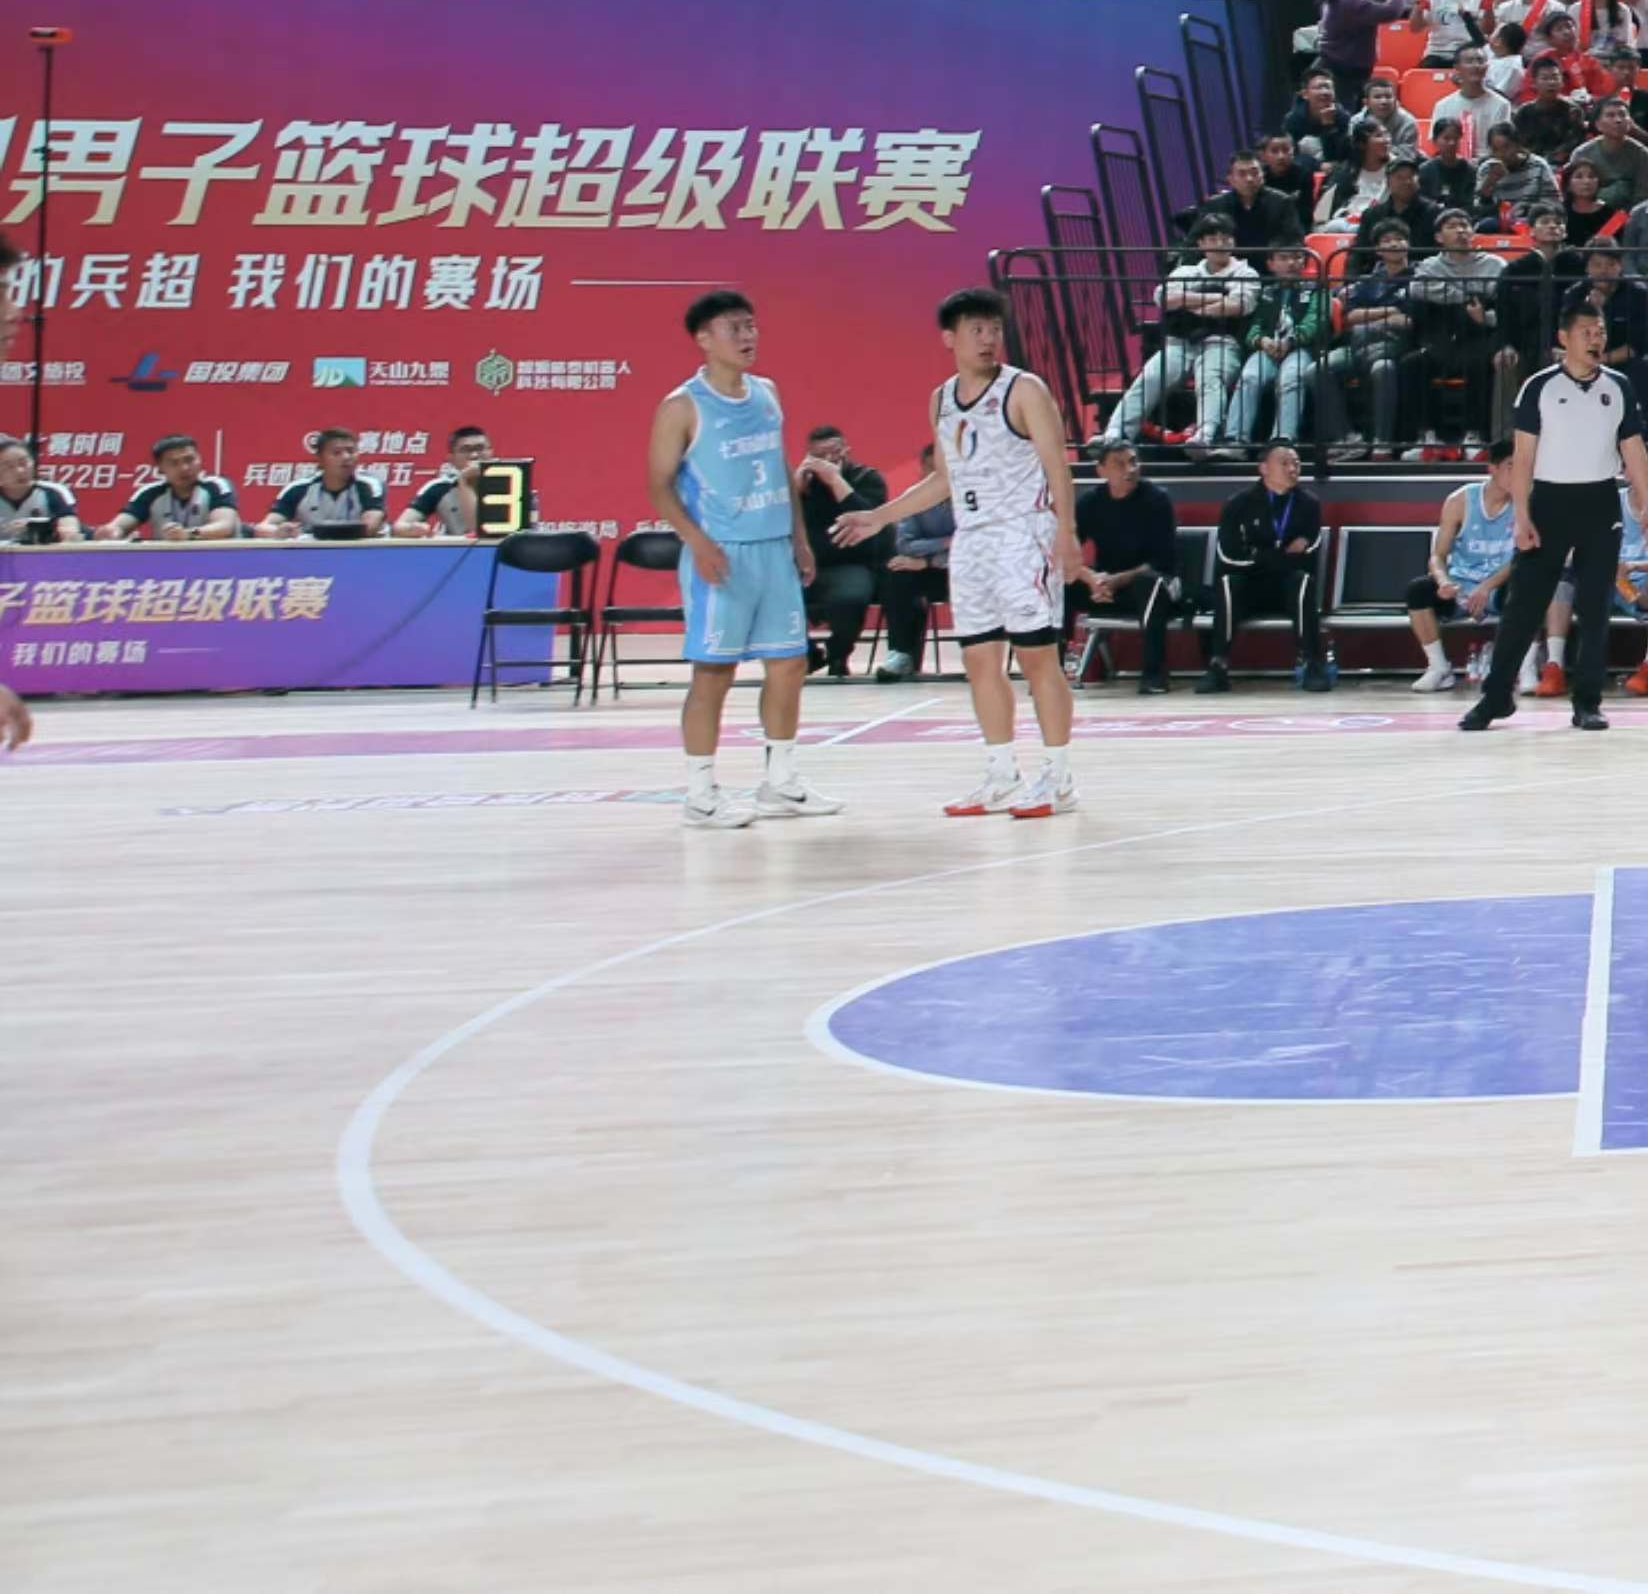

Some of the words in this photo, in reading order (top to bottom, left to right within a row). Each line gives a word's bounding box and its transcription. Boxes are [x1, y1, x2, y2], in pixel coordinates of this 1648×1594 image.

[0, 115, 982, 234] 男子篮球超级联赛
[226, 253, 546, 314] 我们的赛场
[184, 360, 292, 384] 国投集团
[751, 459, 768, 487] 3
[482, 464, 526, 535] 3
[964, 489, 979, 512] 9
[12, 640, 148, 667] 我们的赛场
